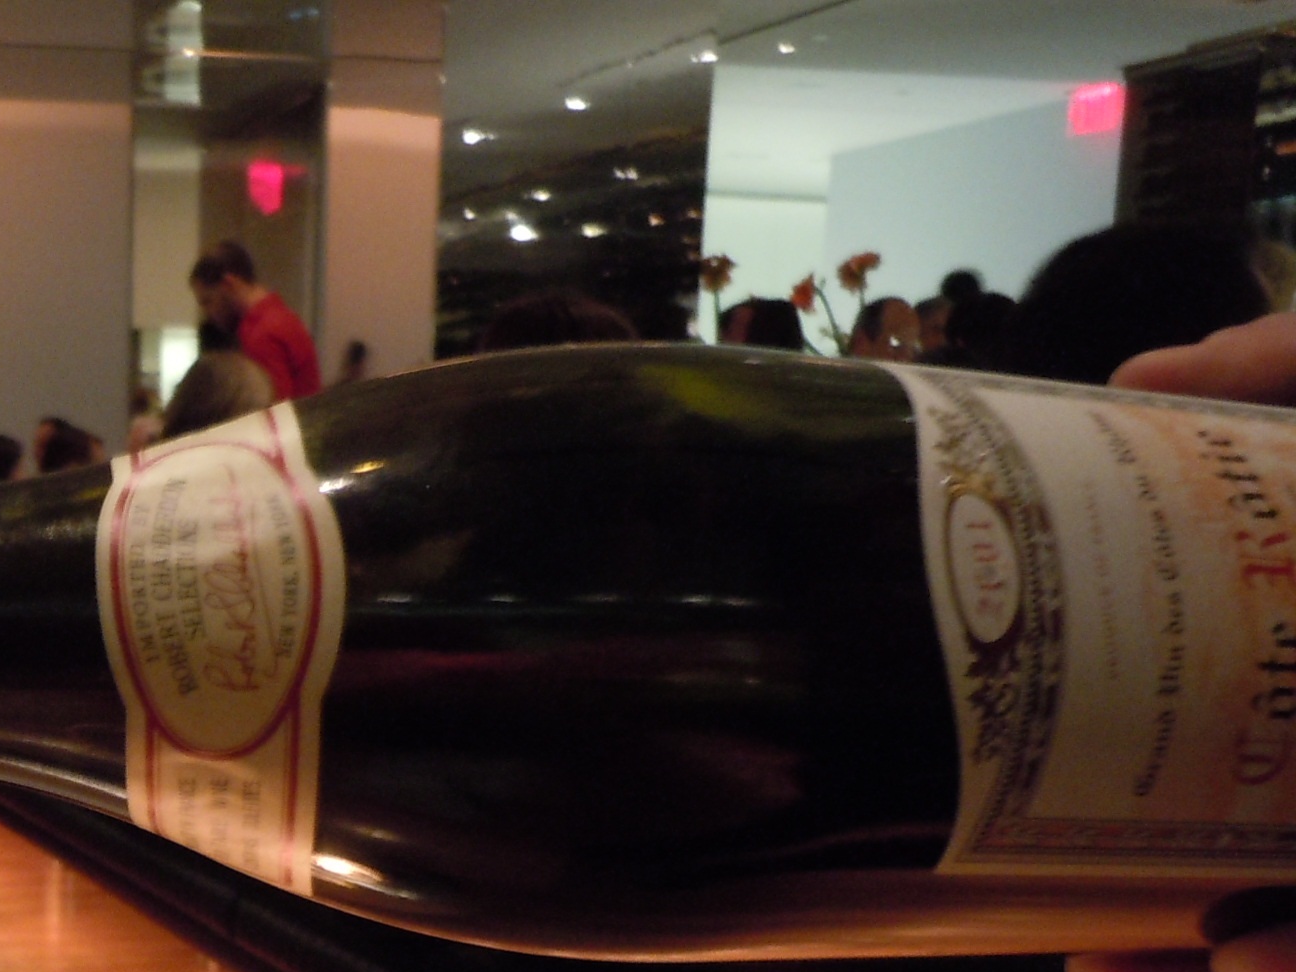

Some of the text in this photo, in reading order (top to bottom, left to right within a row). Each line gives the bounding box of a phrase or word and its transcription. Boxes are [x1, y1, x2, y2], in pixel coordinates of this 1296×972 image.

[278, 534, 297, 566] NEW
[156, 611, 200, 697] ROBERT
[274, 625, 295, 658] NEW
